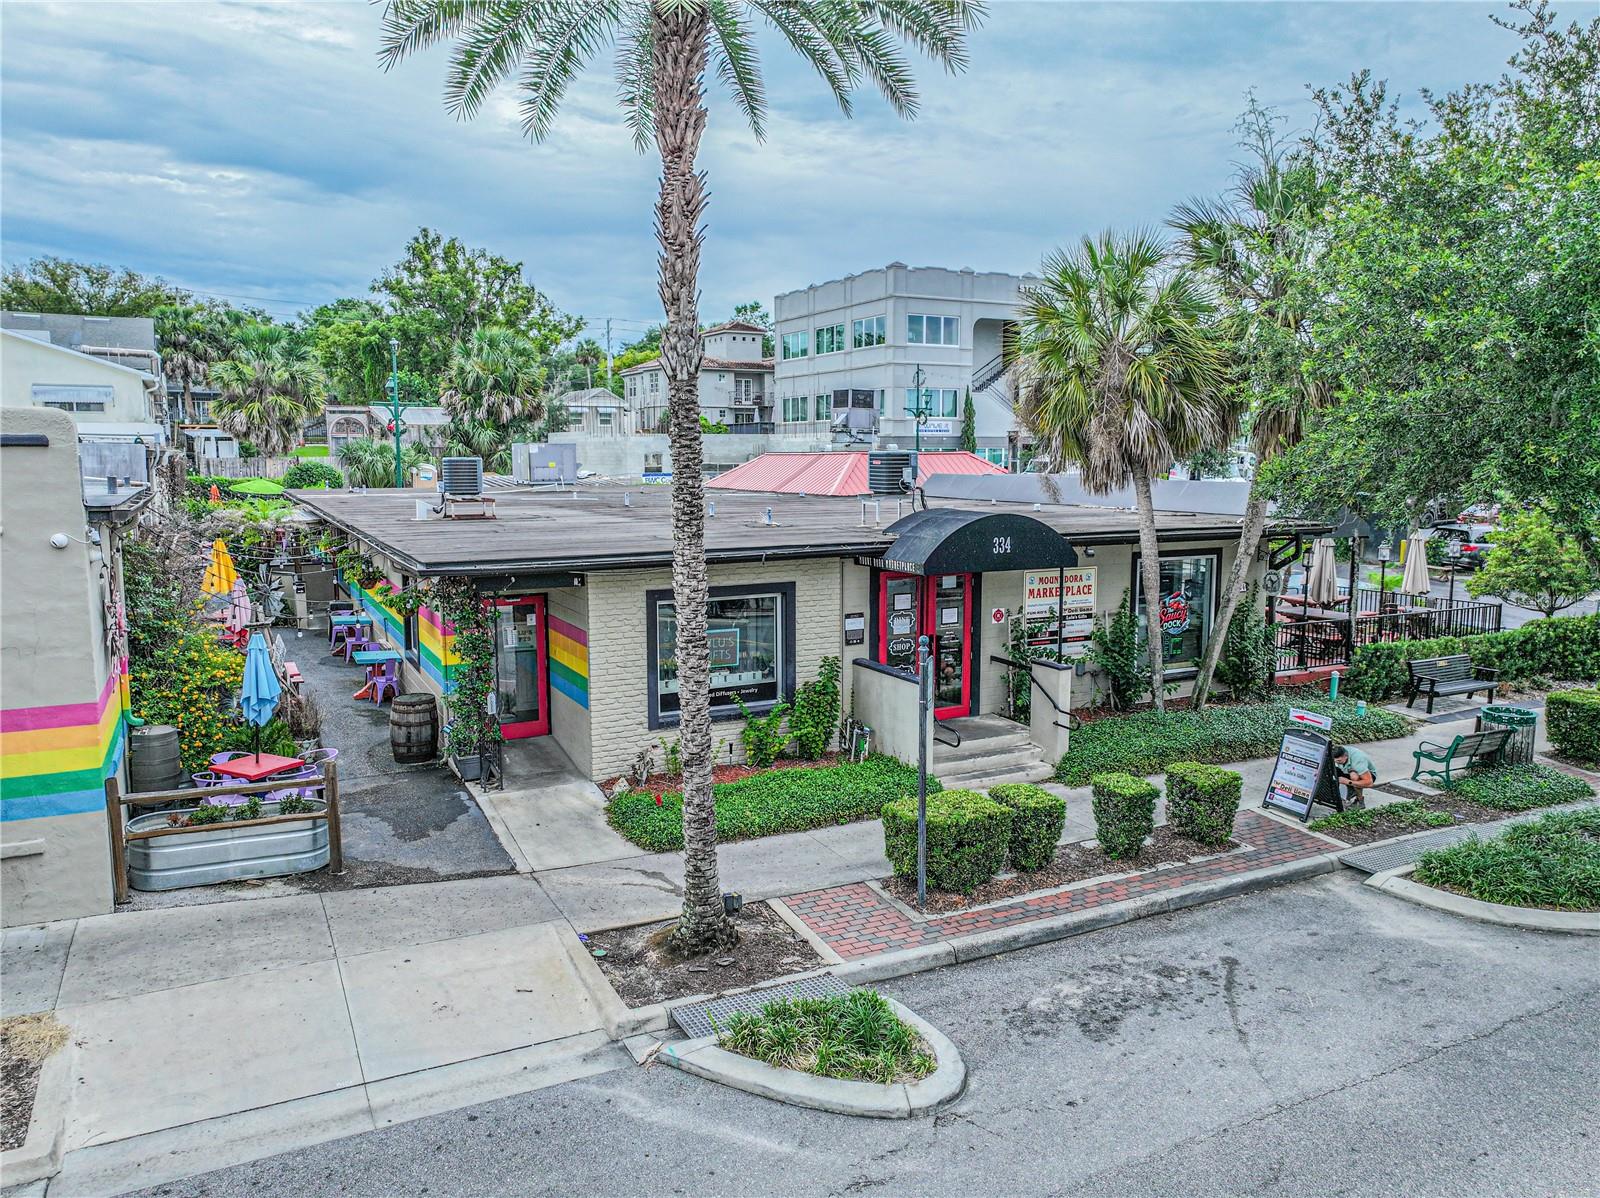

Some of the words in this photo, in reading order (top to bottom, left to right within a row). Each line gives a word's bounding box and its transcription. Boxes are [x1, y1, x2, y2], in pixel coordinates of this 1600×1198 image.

[993, 536, 1011, 553] 334
[1038, 576, 1060, 585] MOUN
[1064, 574, 1083, 584] DORA
[1028, 585, 1092, 599] MARKEPLACE
[1160, 608, 1187, 625] Saucy
[1163, 620, 1181, 630] DOCK
[893, 643, 911, 652] SHOP
